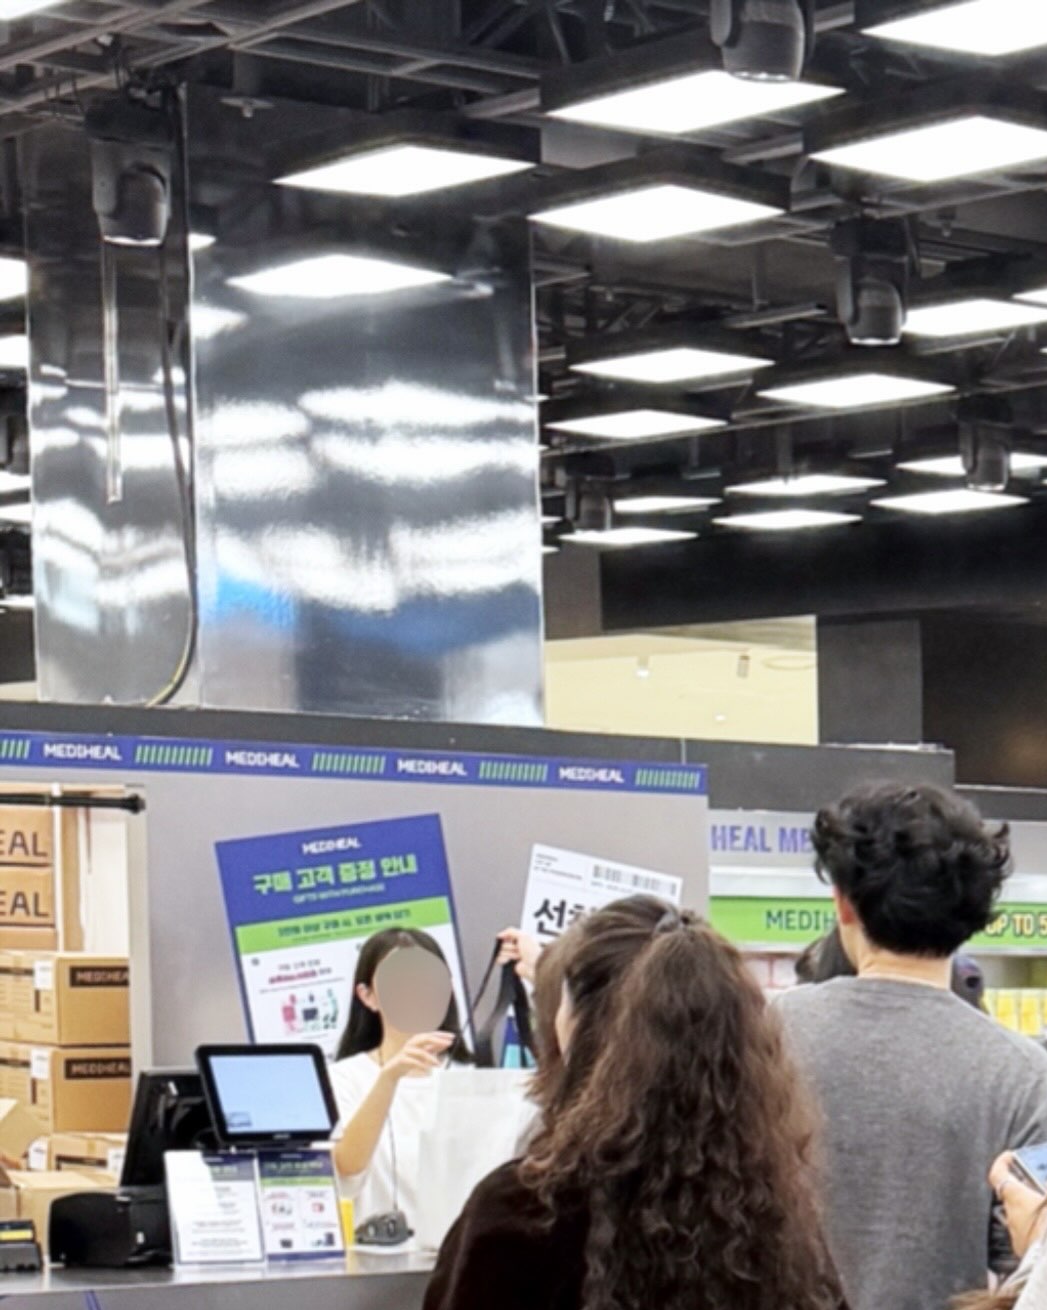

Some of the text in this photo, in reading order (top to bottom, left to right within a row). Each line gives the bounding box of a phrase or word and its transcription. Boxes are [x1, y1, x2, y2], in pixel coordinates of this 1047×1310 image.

[711, 825, 772, 853] HEAL
[296, 865, 335, 889] 고객
[1013, 913, 1034, 935] TO
